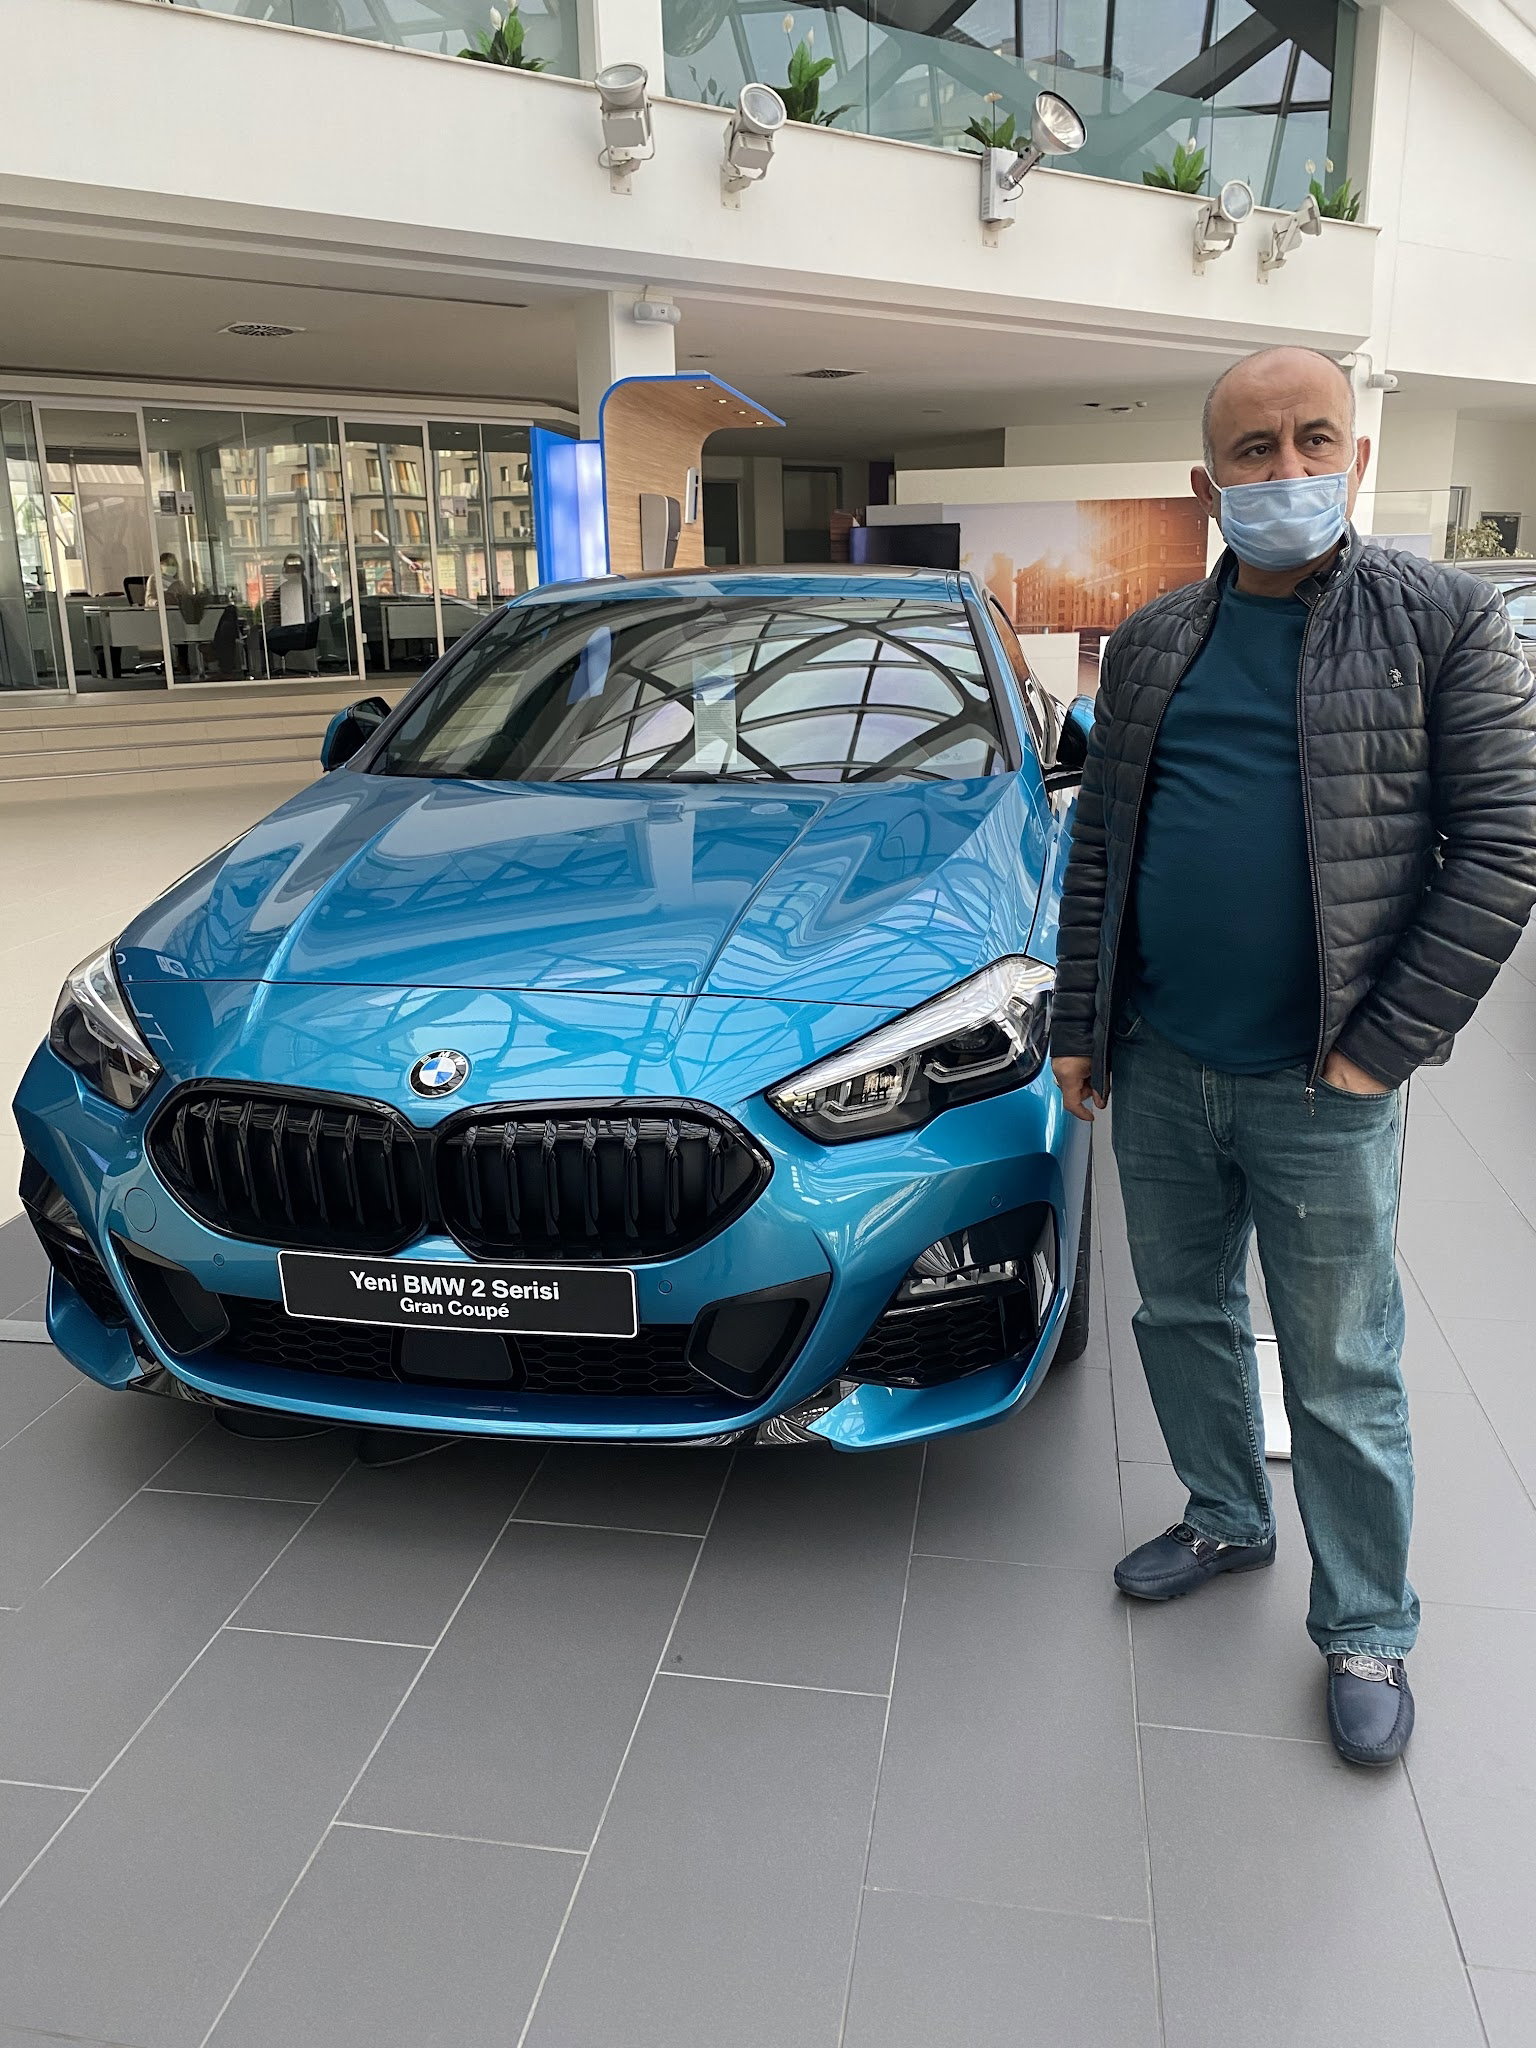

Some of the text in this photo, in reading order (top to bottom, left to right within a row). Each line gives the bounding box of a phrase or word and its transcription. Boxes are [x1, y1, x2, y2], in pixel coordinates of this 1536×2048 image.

[349, 1270, 560, 1300] Yeni BMW 2 Serisi
[400, 1297, 510, 1321] Gran Coupé
